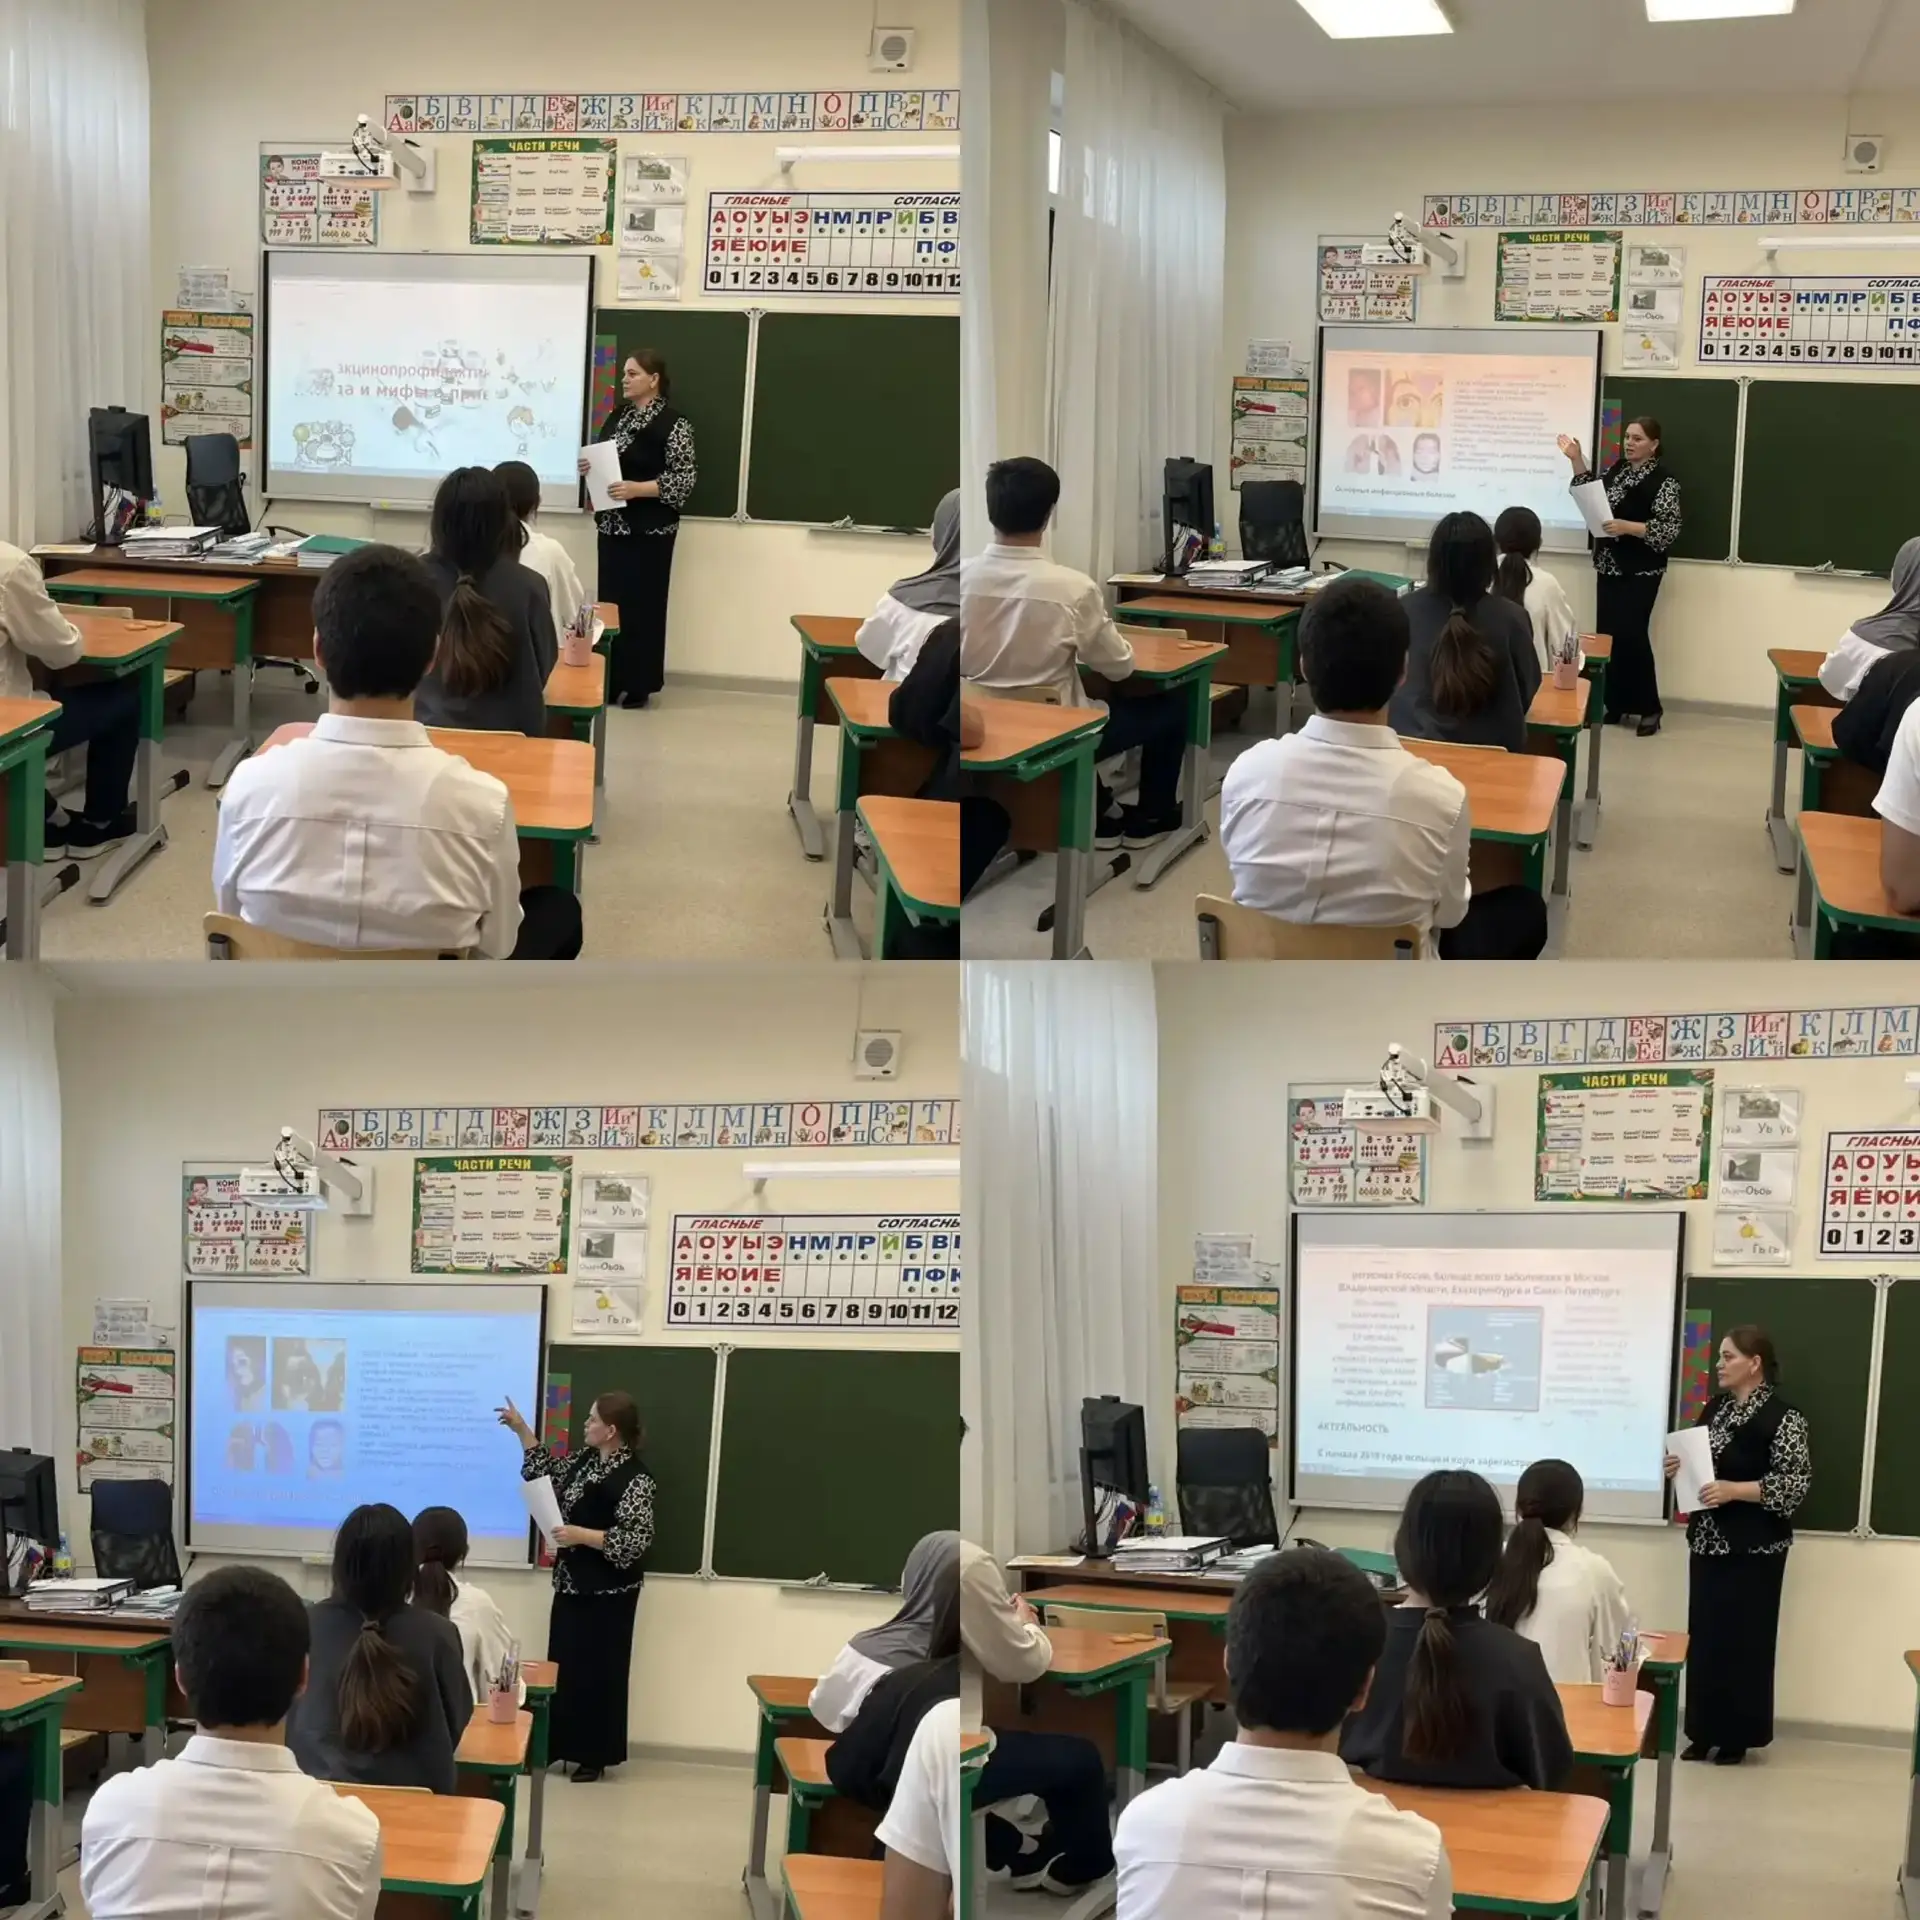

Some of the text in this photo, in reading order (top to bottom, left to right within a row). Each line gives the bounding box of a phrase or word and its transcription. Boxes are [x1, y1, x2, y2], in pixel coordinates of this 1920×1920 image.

[509, 141, 580, 152] ЧАСТИ РЕЧИ
[724, 196, 790, 205] ГЛАСНЫЕ
[894, 196, 960, 205] СОГЛАСН
[713, 209, 958, 223] А О У Ы Э Н М Л Р Й Б В
[712, 237, 956, 252] Я Ё Ю И Е П Ф
[1529, 233, 1591, 243] ЧАСТИ РЕЧИ
[710, 271, 721, 283] 0
[731, 272, 739, 283] 1
[750, 272, 761, 284] 2
[767, 272, 779, 284] 3
[787, 272, 799, 284] 4
[807, 273, 818, 285] 5
[826, 273, 838, 285] 6
[847, 273, 858, 285] 7
[866, 274, 878, 285] 8
[886, 274, 898, 286] 9
[905, 274, 922, 286] 10
[925, 274, 942, 286] 11
[1716, 280, 1775, 288] ГЛАСНЫЕ
[1704, 344, 1913, 358] 0 1 2 3 4 5 6 7 8 9 10 11
[1583, 1072, 1668, 1088] ЧАСТИ РЕЧИ
[1846, 1136, 1920, 1147] ГЛАСНЫ
[454, 1159, 531, 1170] ЧАСТИ РЕЧИ
[1832, 1154, 1848, 1169] А
[1856, 1154, 1875, 1169] О
[1882, 1154, 1900, 1169] У
[1829, 1190, 1847, 1205] Я
[1854, 1187, 1872, 1205] Ё
[1876, 1190, 1900, 1205] Ю
[690, 1219, 763, 1229] ГЛАСНЫЕ
[677, 1234, 948, 1249] А О У Ы Э Н М Л Р Й Б В
[1827, 1229, 1914, 1245] 0 1 2 3
[675, 1265, 945, 1281] Я Ё Ю И Е П Ф
[674, 1302, 958, 1320] 0 1 2 3 4 5 6 7 8 9 10 11 12
